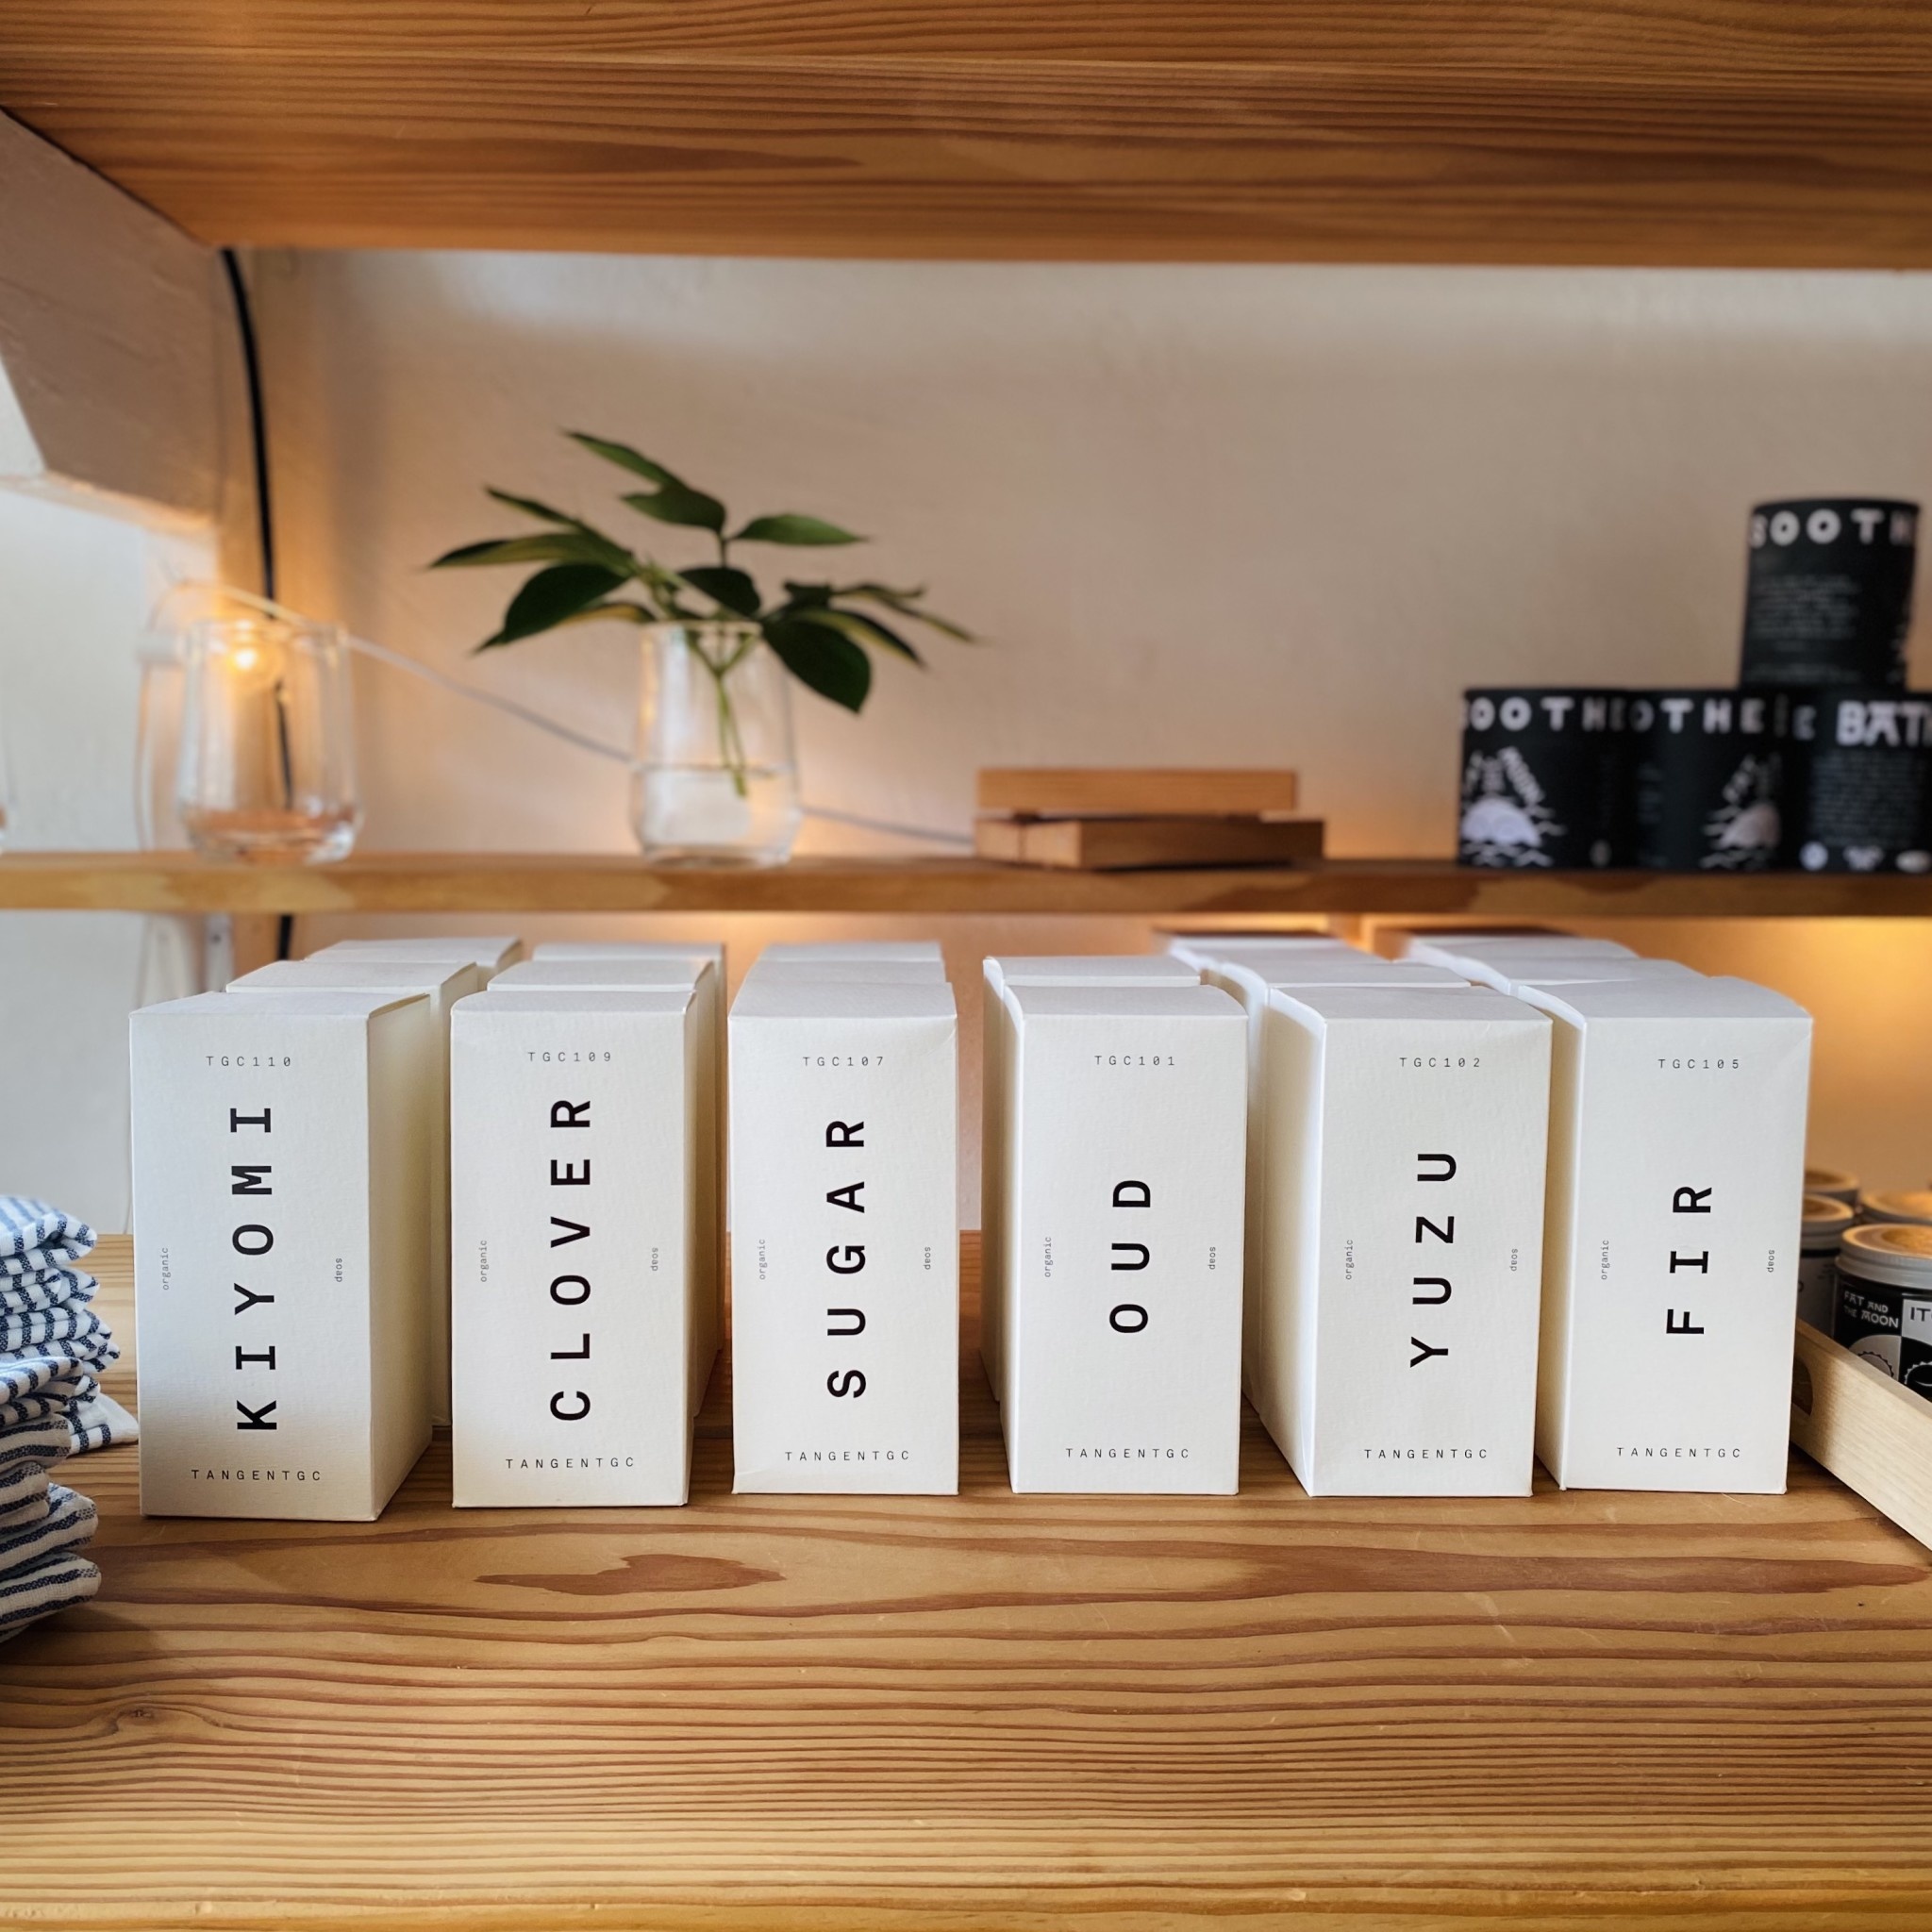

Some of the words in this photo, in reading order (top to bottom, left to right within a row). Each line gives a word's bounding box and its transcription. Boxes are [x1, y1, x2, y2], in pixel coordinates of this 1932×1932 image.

[206, 1056, 291, 1068] TGC110
[527, 1051, 611, 1063] TGC109
[803, 1056, 884, 1067] TGC107
[1094, 1055, 1175, 1066] TGC101
[1399, 1057, 1480, 1068] TGC102
[1657, 1058, 1740, 1070] TGC105
[160, 1247, 171, 1291] organic
[477, 1240, 489, 1283] organic
[549, 1099, 591, 1422] CLOVER
[650, 1247, 659, 1272] soap
[757, 1239, 767, 1280] organic
[825, 1120, 867, 1399] SUGAR
[924, 1246, 932, 1271] soap
[1043, 1237, 1054, 1278] organic
[1108, 1179, 1151, 1334] OUD
[1207, 1246, 1217, 1271] soap
[1344, 1239, 1355, 1280] organic
[1409, 1153, 1457, 1368] YUZU
[1509, 1248, 1519, 1272] soap
[1600, 1240, 1610, 1280] organic
[1665, 1186, 1712, 1335] FIR
[1766, 1249, 1775, 1274] soap
[229, 1108, 277, 1431] KIYOMI
[334, 1257, 343, 1283] soap
[1844, 1291, 1865, 1307] FAT
[1867, 1301, 1890, 1313] AND
[1860, 1309, 1899, 1328] MOON
[1910, 1307, 1932, 1323] IT
[506, 1457, 634, 1469] TANGENTGC
[785, 1450, 909, 1461] TANGENTGC
[1065, 1447, 1189, 1459] TANGENTGC
[1364, 1448, 1487, 1459] TANGENTGC
[1616, 1446, 1740, 1458] TANGENTGC
[192, 1469, 321, 1482] TANGENTGC
